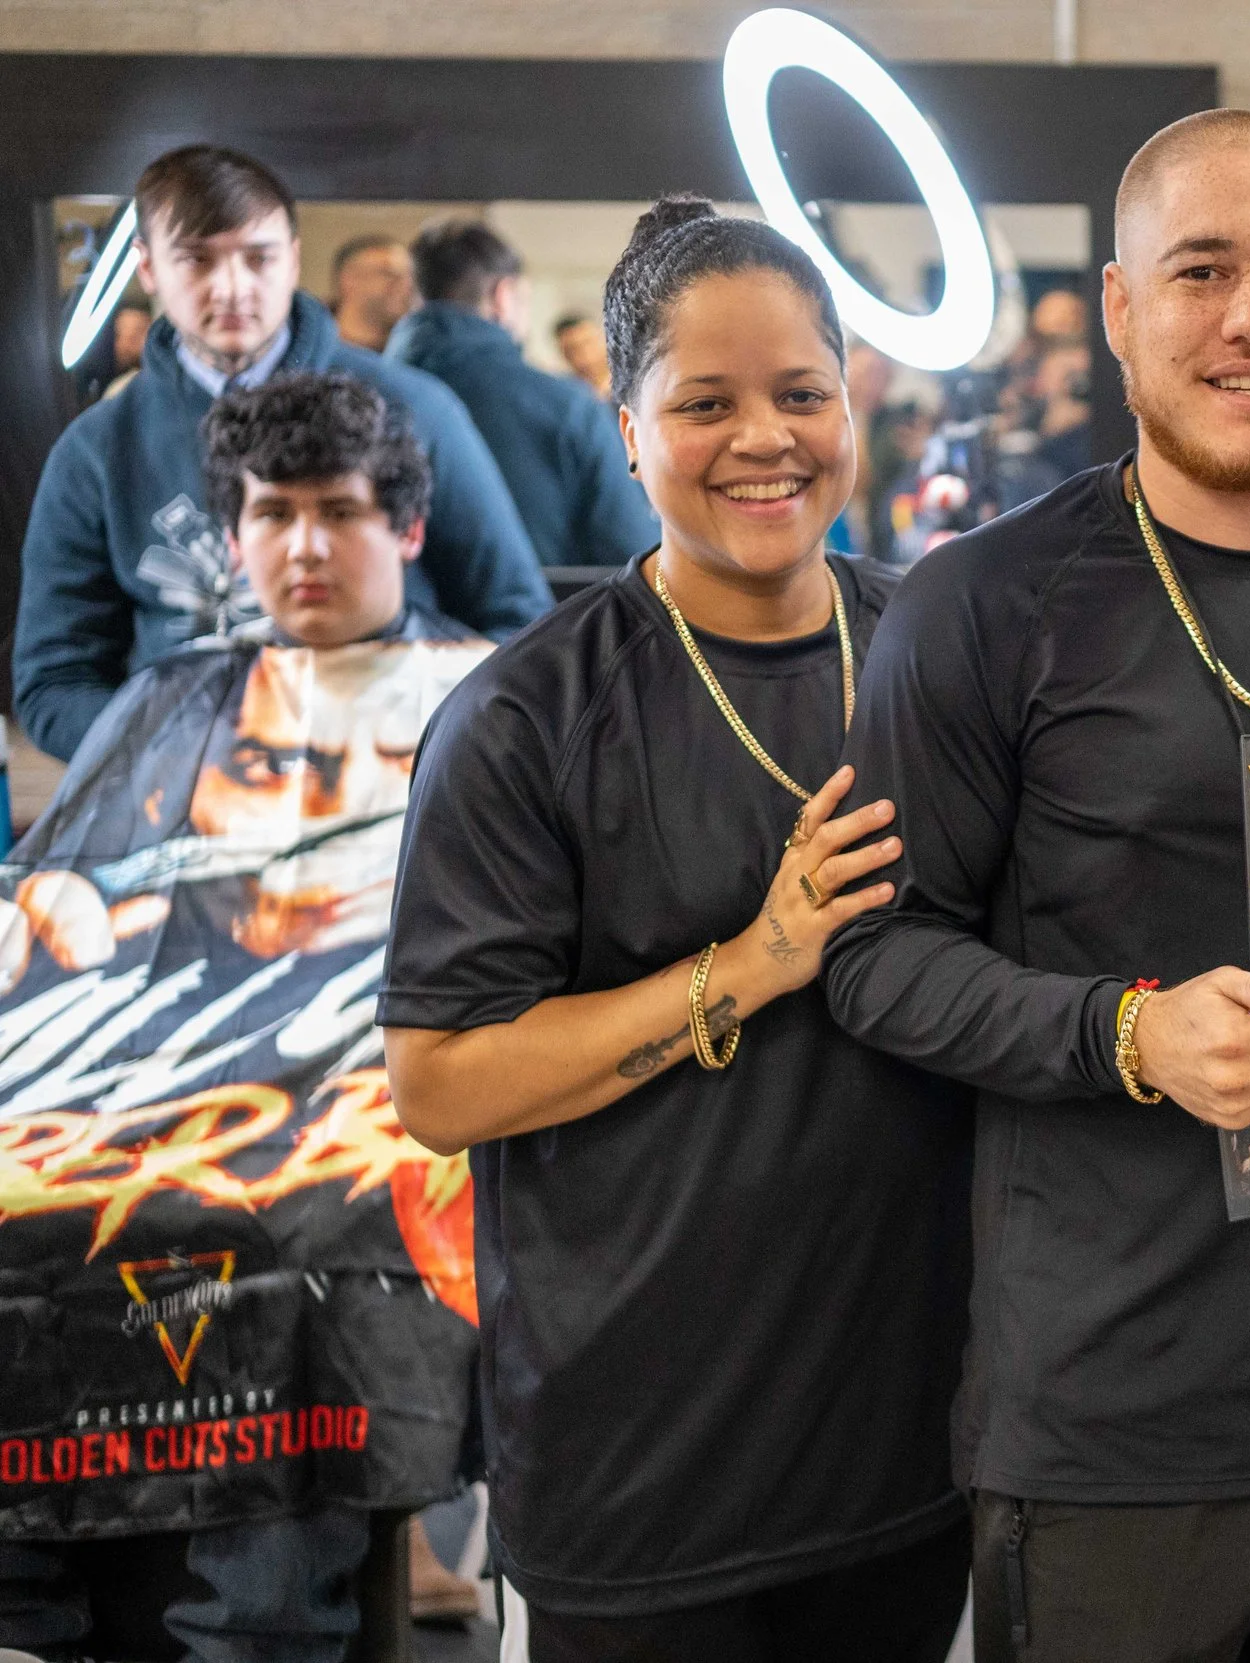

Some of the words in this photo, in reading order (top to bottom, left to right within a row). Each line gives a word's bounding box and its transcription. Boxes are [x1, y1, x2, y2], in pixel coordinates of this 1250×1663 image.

[246, 1389, 275, 1411] BY
[0, 1431, 130, 1484] OLDEN
[145, 1419, 230, 1472] CUTS
[234, 1404, 369, 1464] STUDIO
